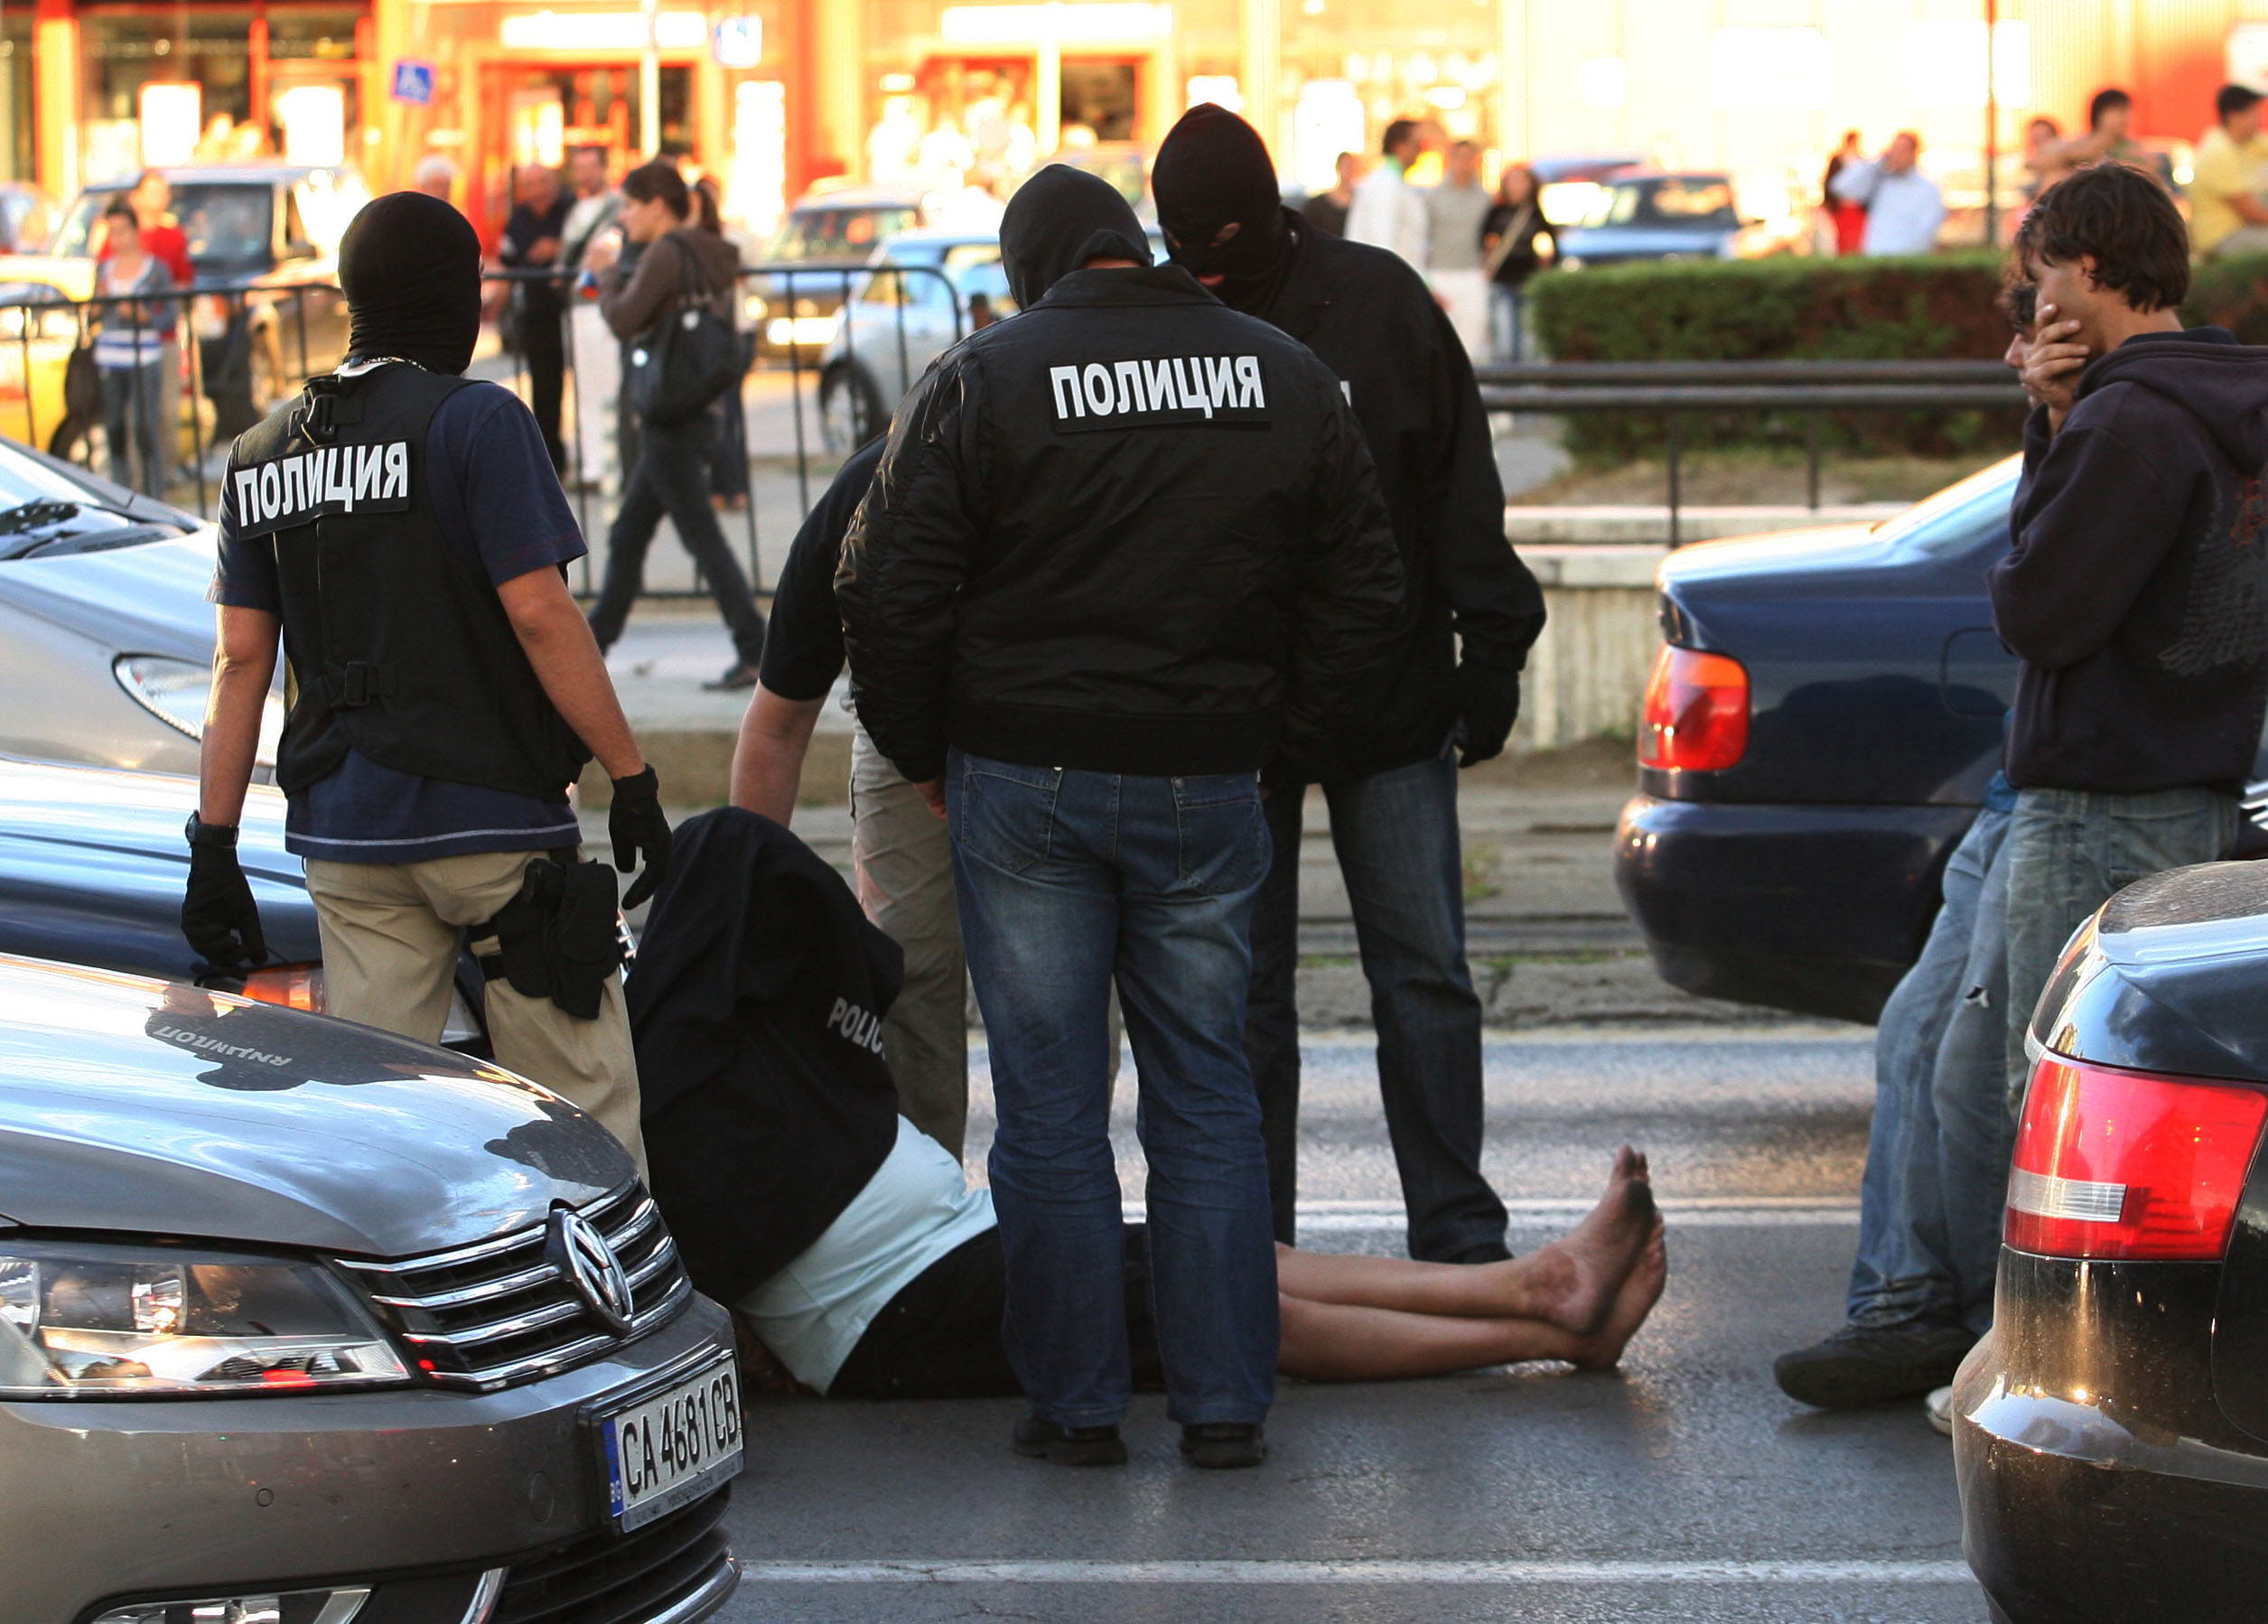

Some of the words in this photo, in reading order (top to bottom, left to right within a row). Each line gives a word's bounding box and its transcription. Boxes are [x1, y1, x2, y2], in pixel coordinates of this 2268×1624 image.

[1050, 356, 1265, 419] ПОЛИЦИЯ
[234, 442, 407, 527] ПОЛИЦИЯ
[826, 996, 886, 1061] POLIC
